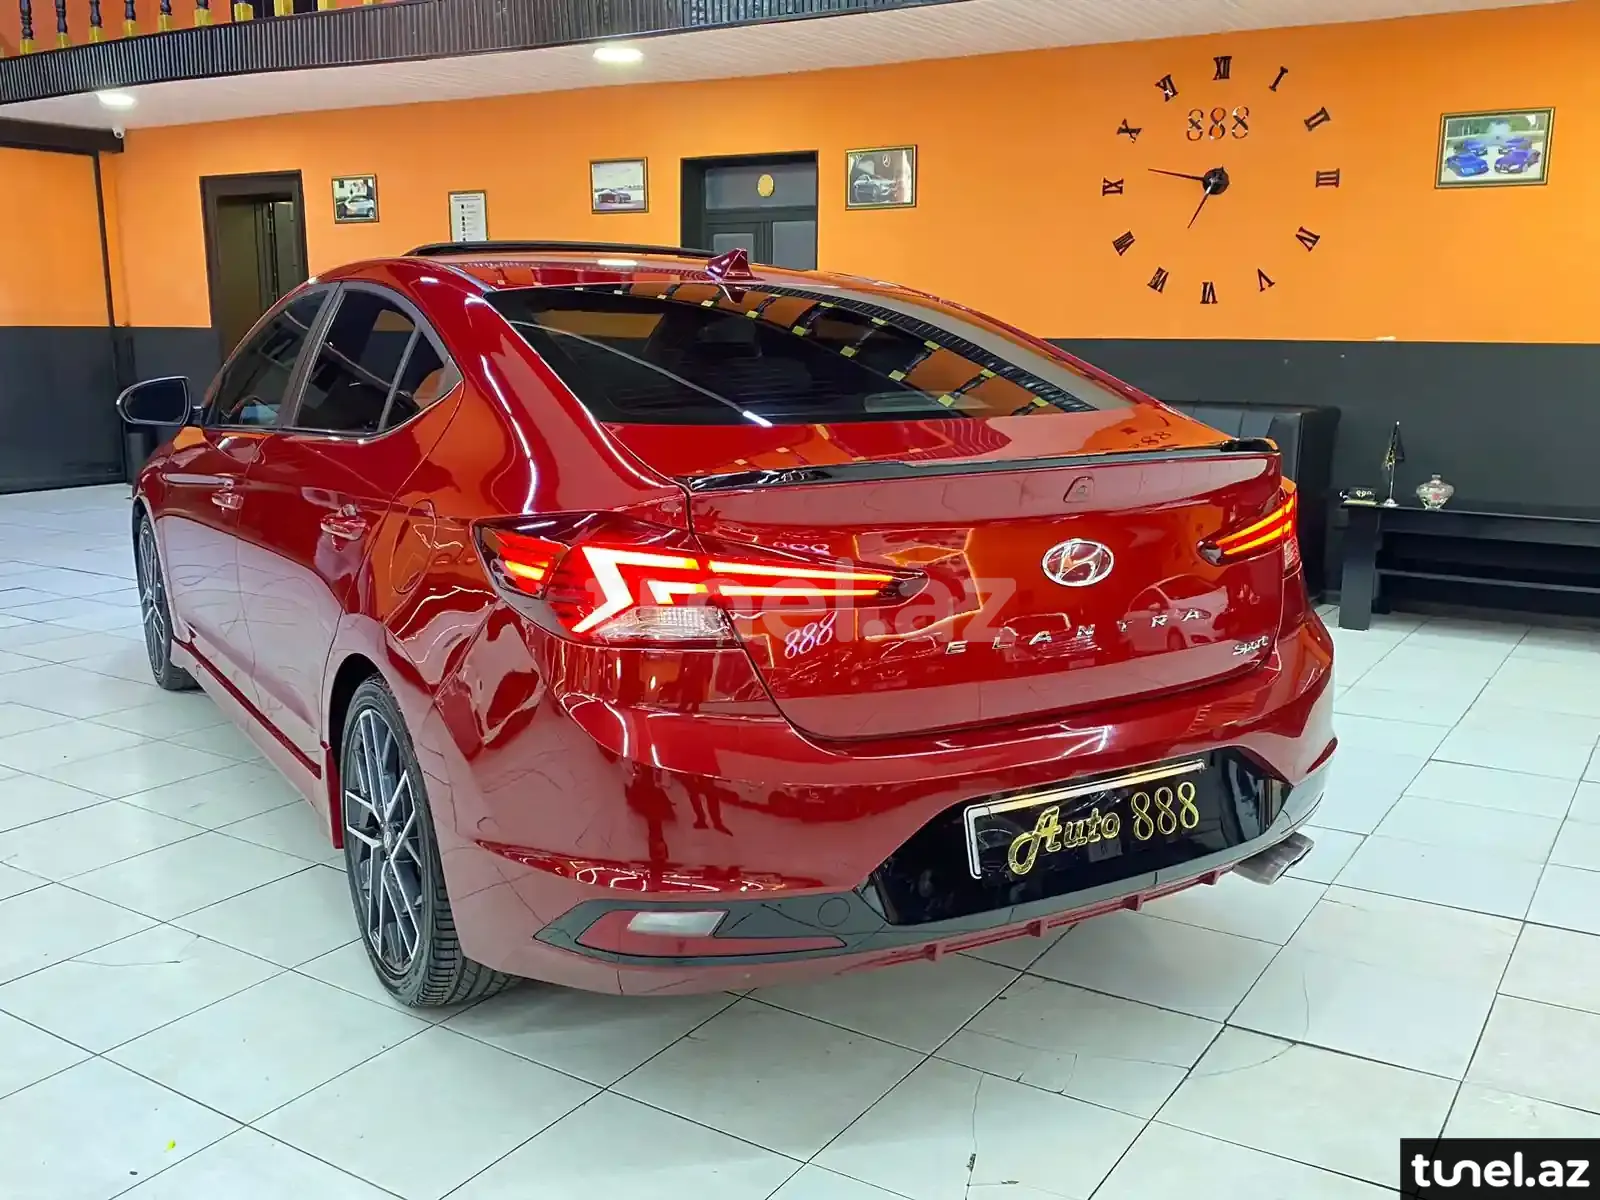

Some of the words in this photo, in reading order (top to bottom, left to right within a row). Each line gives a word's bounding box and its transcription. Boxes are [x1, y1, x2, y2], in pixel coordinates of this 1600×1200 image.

[1213, 56, 1232, 80] XII
[1269, 66, 1288, 92] I
[1117, 119, 1142, 143] X
[1186, 106, 1249, 141] 888
[1304, 107, 1330, 131] II
[1102, 178, 1123, 196] IX
[1316, 169, 1339, 187] III
[1200, 282, 1217, 304] VI
[945, 608, 1200, 655] ELANTRA
[1232, 635, 1269, 656] Sport
[1007, 805, 1121, 876] Auto
[1130, 782, 1200, 841] 888
